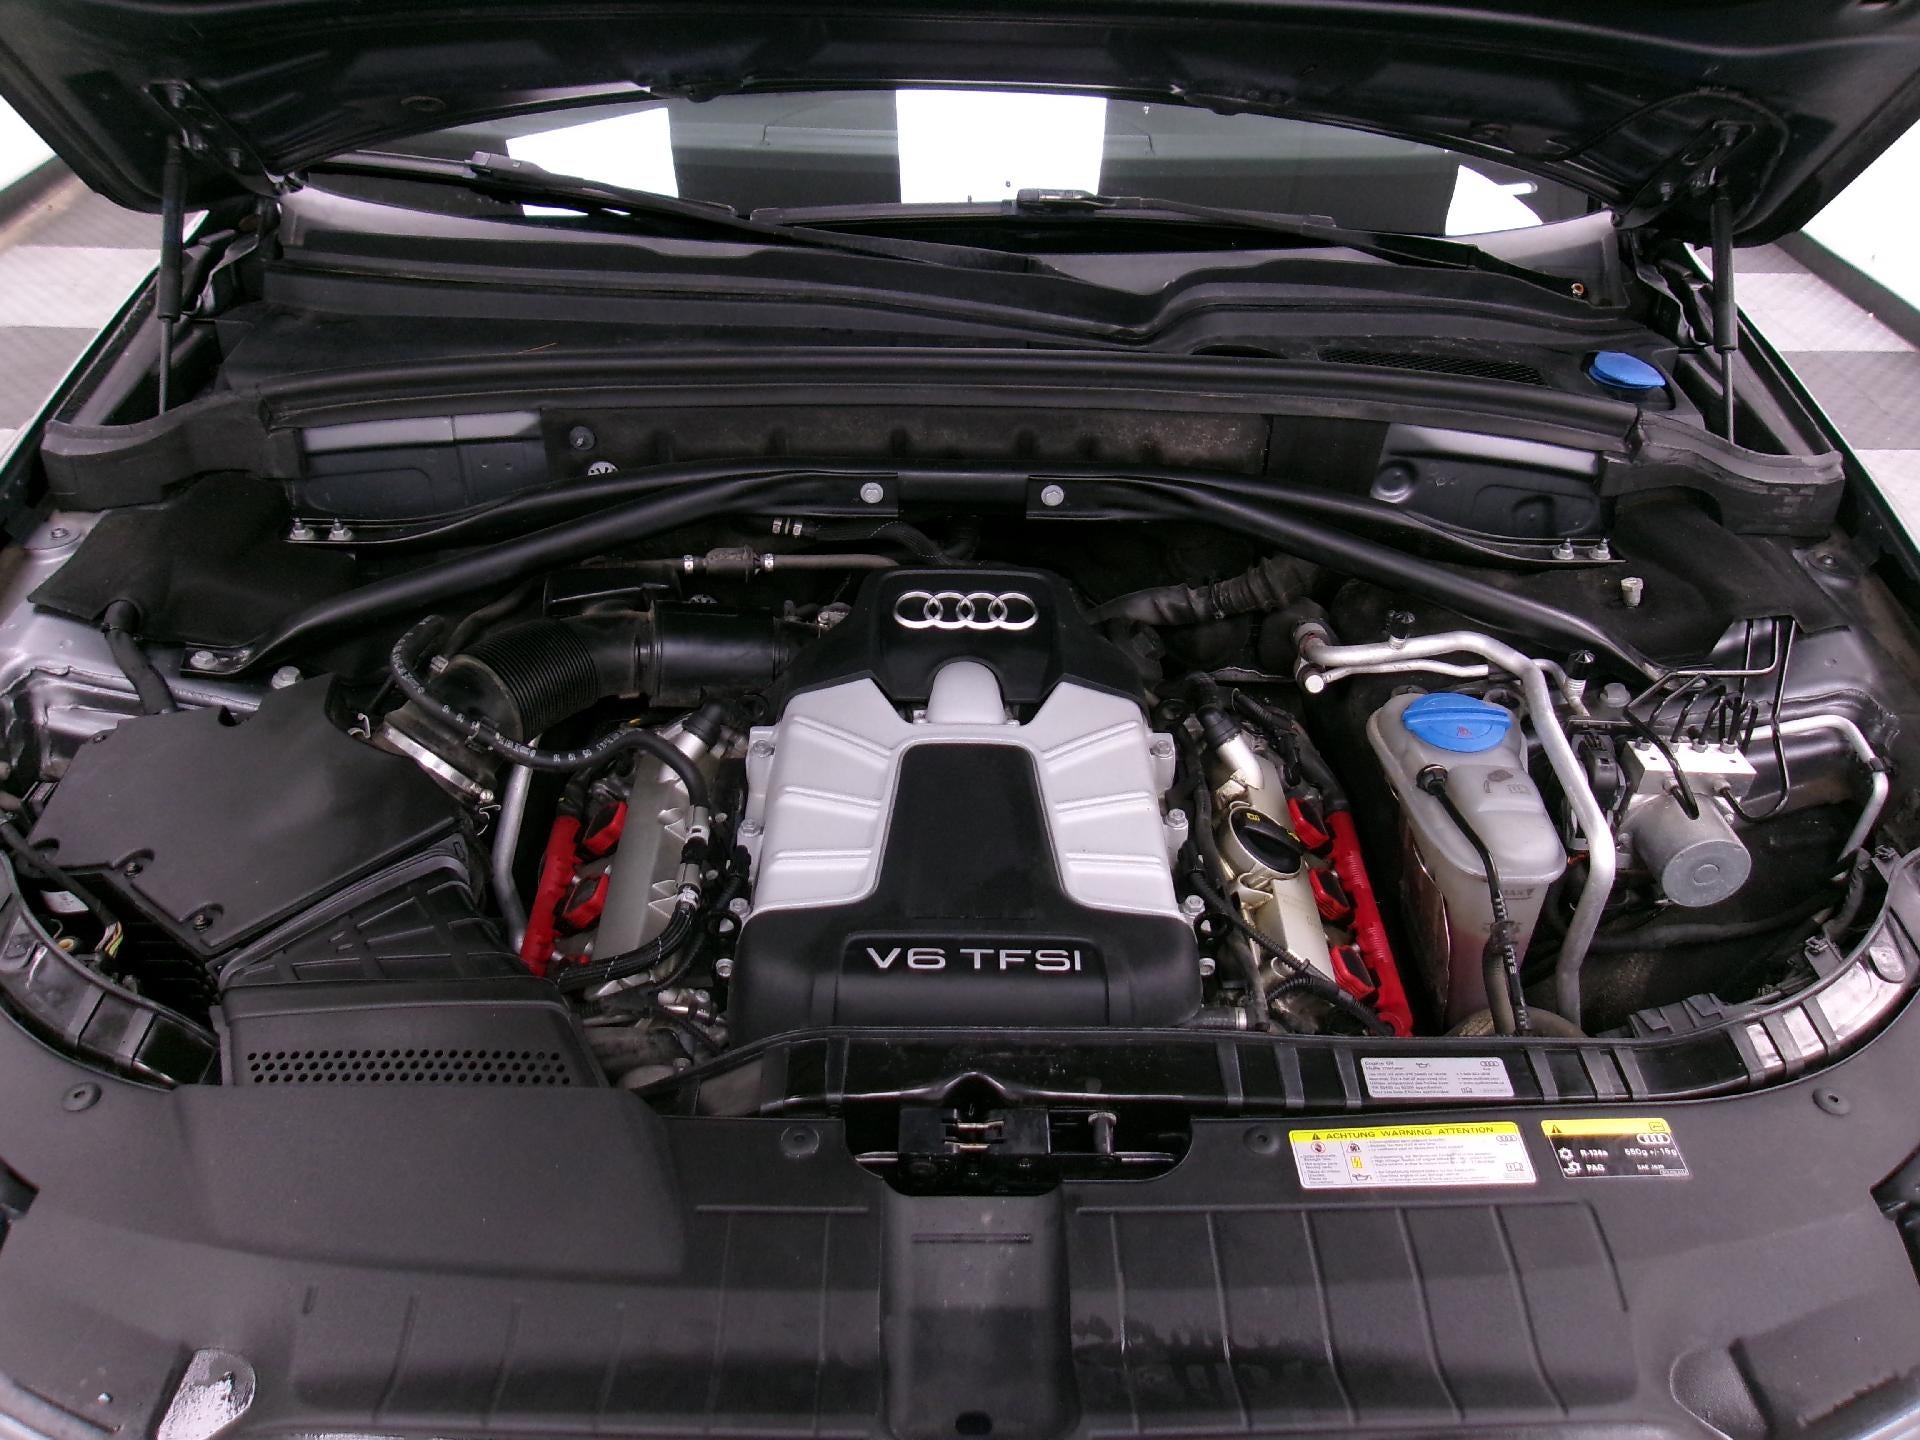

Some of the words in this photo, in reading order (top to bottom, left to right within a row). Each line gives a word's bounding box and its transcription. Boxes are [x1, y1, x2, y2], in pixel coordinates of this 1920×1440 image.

[866, 947, 946, 969] V6
[959, 948, 1081, 971] TFSI
[1326, 1131, 1376, 1140] ACHTUNG
[1381, 1128, 1432, 1137] WARNING
[1438, 1126, 1494, 1135] ATTENTION
[1585, 1163, 1605, 1172] PAG
